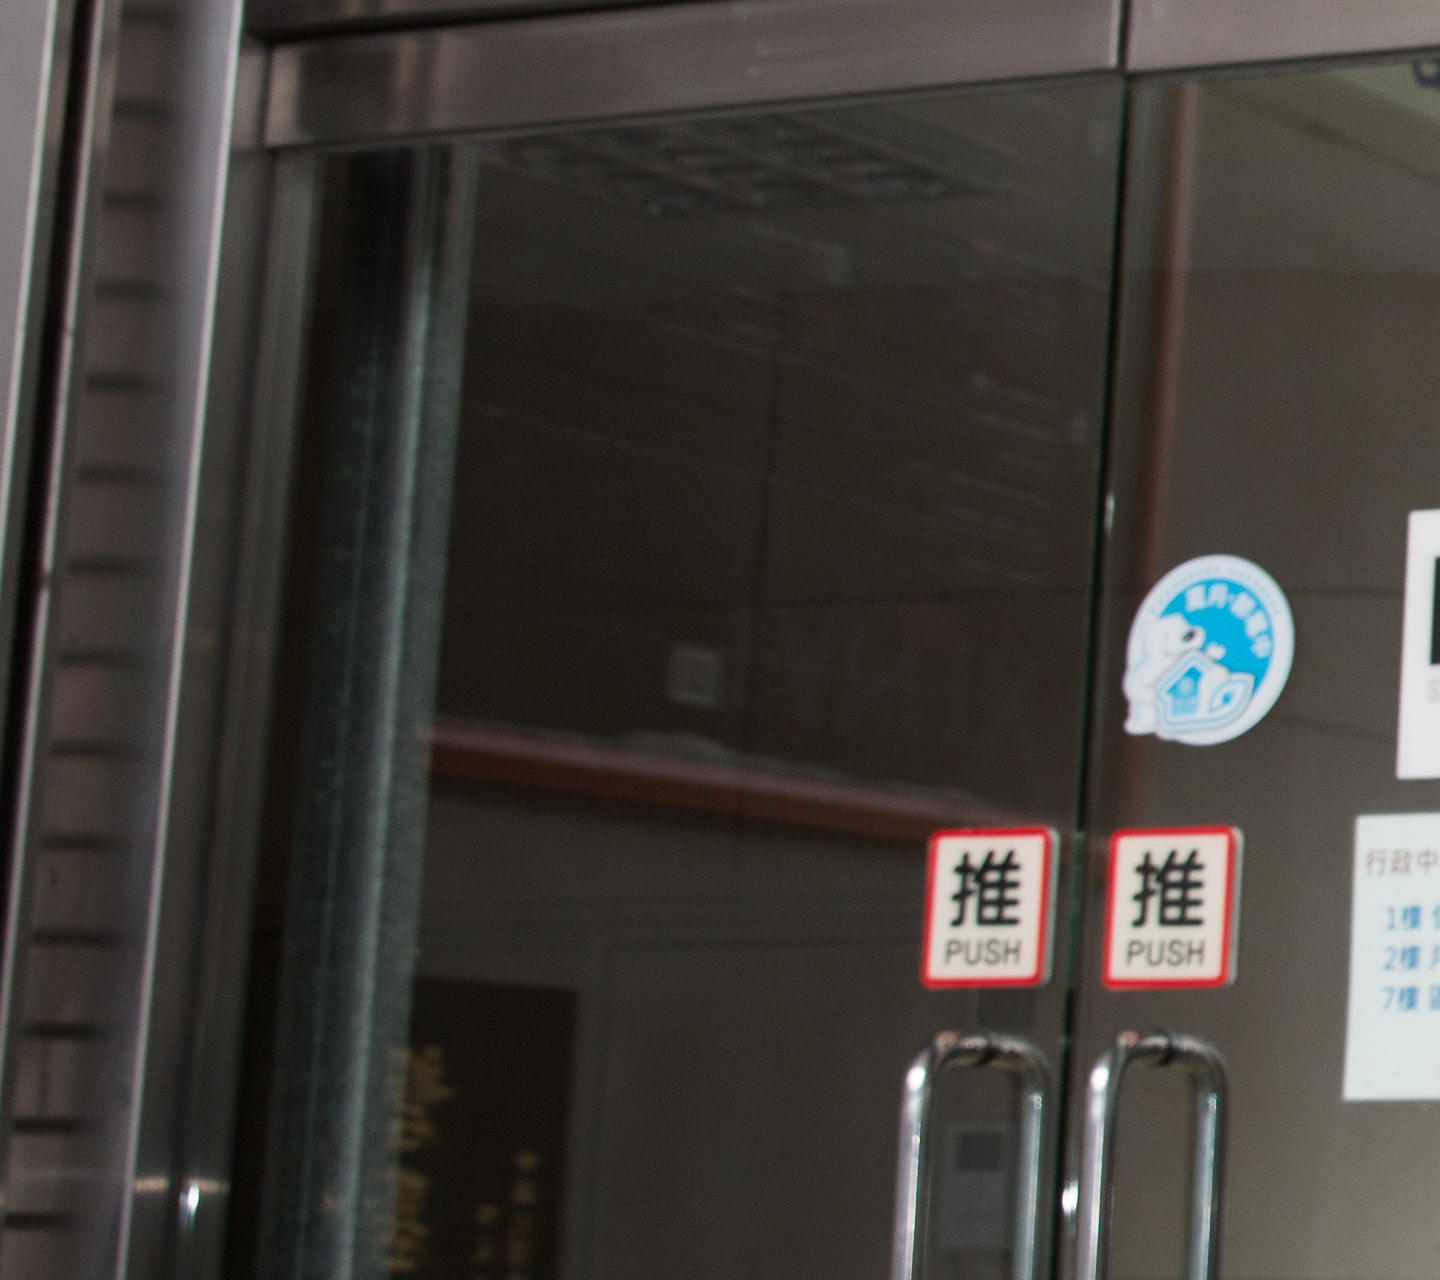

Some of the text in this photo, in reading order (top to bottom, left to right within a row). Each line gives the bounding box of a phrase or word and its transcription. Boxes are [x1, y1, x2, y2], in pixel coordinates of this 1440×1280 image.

[951, 849, 1021, 927] 推
[1132, 849, 1204, 927] 推
[1386, 905, 1422, 930] 1樓
[945, 939, 1022, 966] PUSH
[1126, 939, 1206, 966] PUSH
[1383, 945, 1421, 971] 2樓
[1382, 986, 1419, 1011] 7樓
